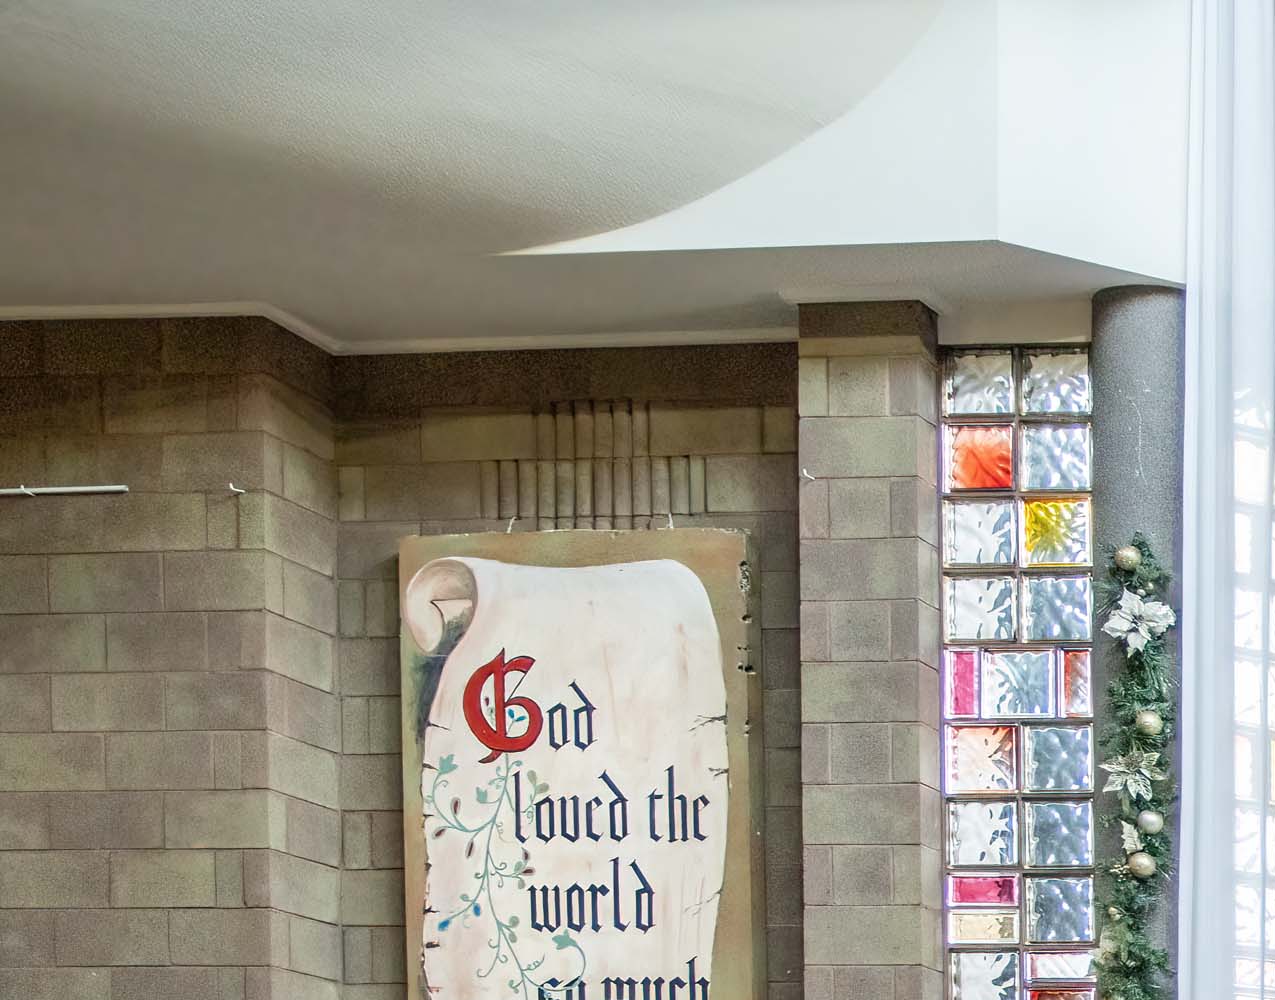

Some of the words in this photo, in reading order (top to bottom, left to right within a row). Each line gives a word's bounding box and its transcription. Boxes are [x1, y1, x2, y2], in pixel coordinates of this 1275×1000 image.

[462, 647, 597, 763] God
[512, 769, 629, 843] loved
[647, 765, 710, 842] the
[527, 856, 656, 935] world
